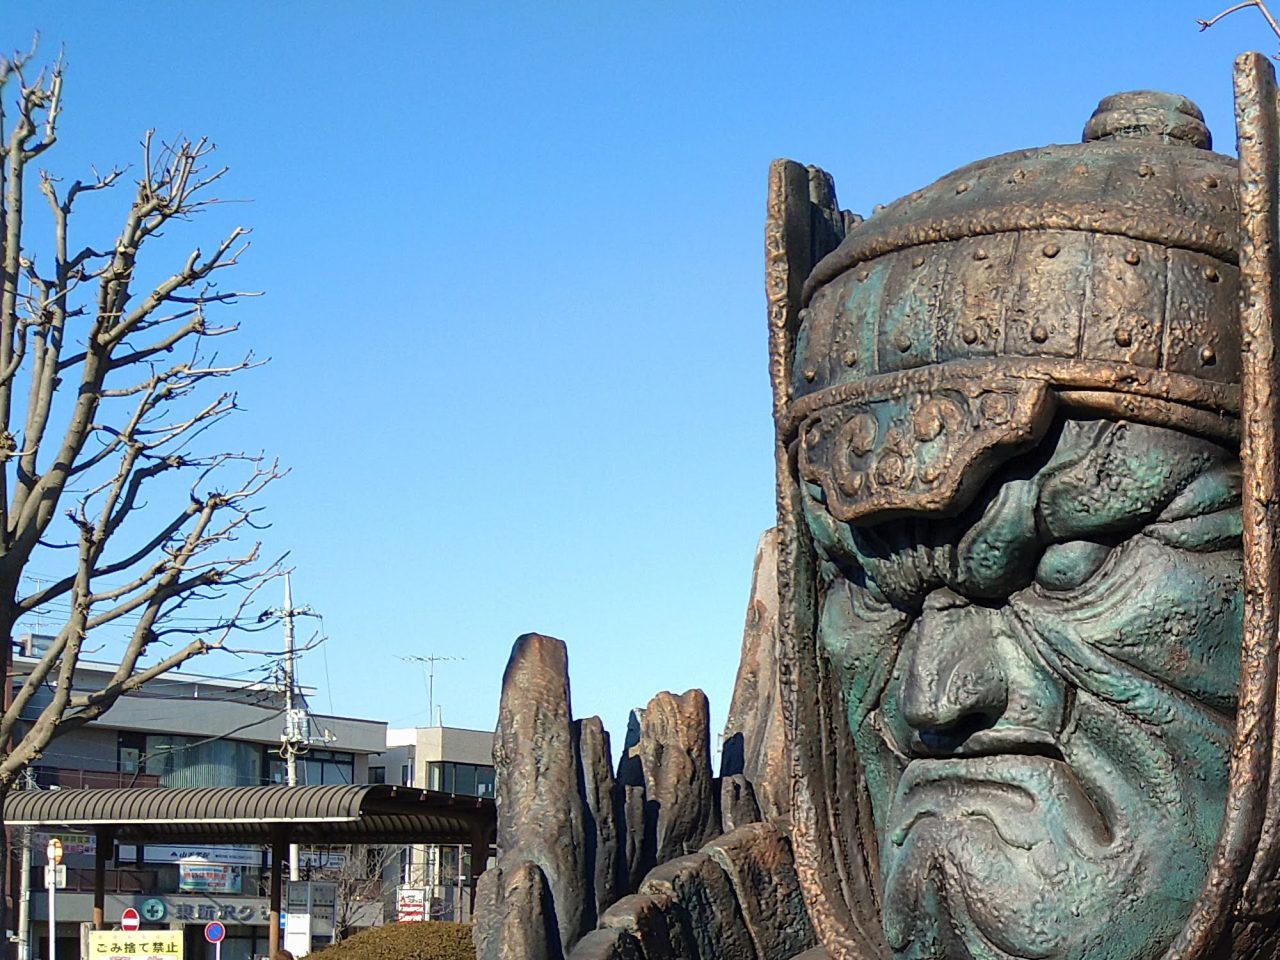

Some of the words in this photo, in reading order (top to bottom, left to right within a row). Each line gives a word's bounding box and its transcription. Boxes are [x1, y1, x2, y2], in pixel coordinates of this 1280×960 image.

[97, 942, 178, 953] ごみ捨て禁止
